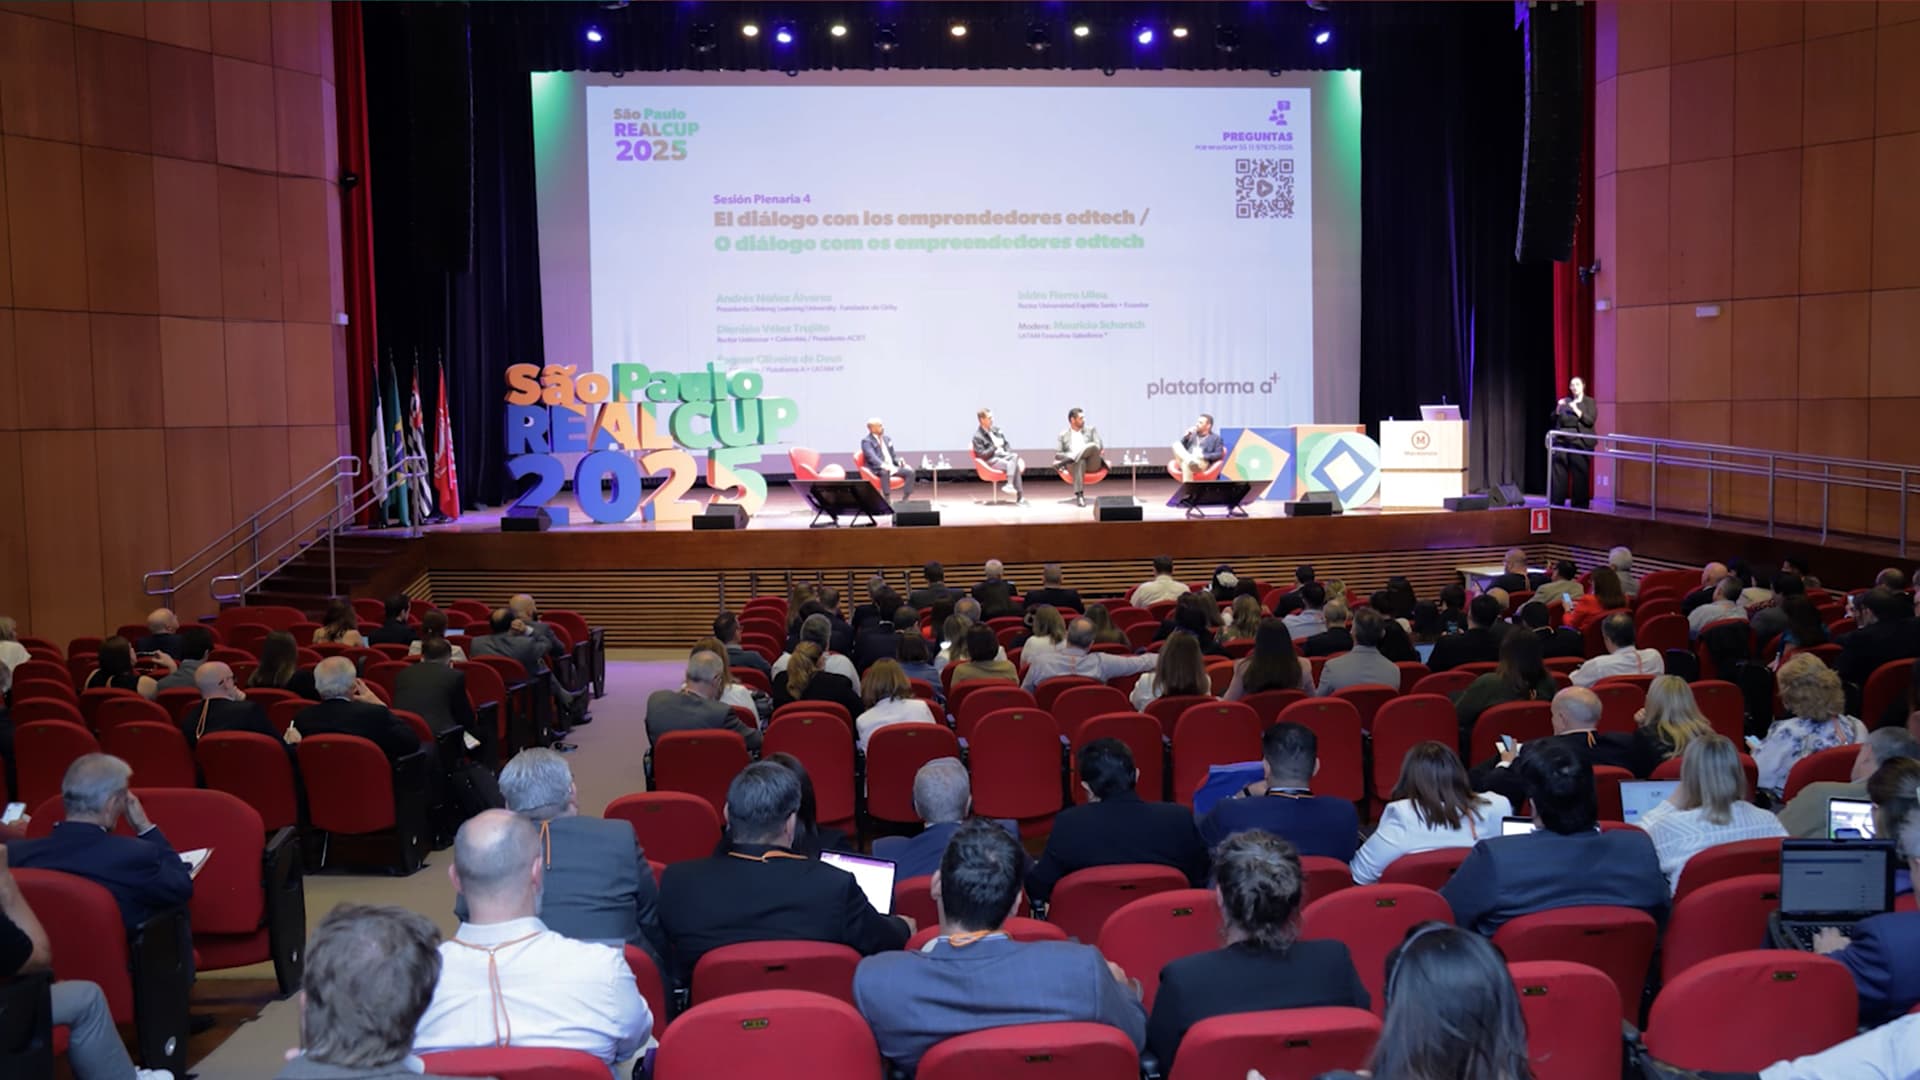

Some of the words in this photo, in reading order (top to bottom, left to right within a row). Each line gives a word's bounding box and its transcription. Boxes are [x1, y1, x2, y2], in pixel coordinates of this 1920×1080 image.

[613, 107, 641, 120] São
[644, 107, 686, 120] Paulo
[614, 122, 700, 137] REALCUP
[1223, 132, 1293, 142] PREGUNTAS
[616, 140, 688, 161] 2025
[713, 193, 752, 205] Sesión
[754, 193, 801, 204] Plenaria
[803, 194, 811, 204] 4
[714, 211, 733, 226] El
[737, 209, 819, 229] diálogo
[822, 212, 859, 226] con
[863, 210, 893, 226] los
[897, 208, 1062, 229] emprendedores
[1065, 208, 1135, 225] edtech
[714, 235, 731, 251] O
[735, 233, 817, 253] diálogo
[820, 237, 863, 251] com
[867, 237, 891, 250] os
[894, 234, 1072, 253] empreendedores
[1075, 234, 1145, 249] edtech
[505, 363, 610, 406] São
[612, 361, 763, 403] Paulo
[1146, 377, 1254, 399] plataforma
[505, 398, 799, 454] REALCUP
[504, 448, 768, 526] 2025
